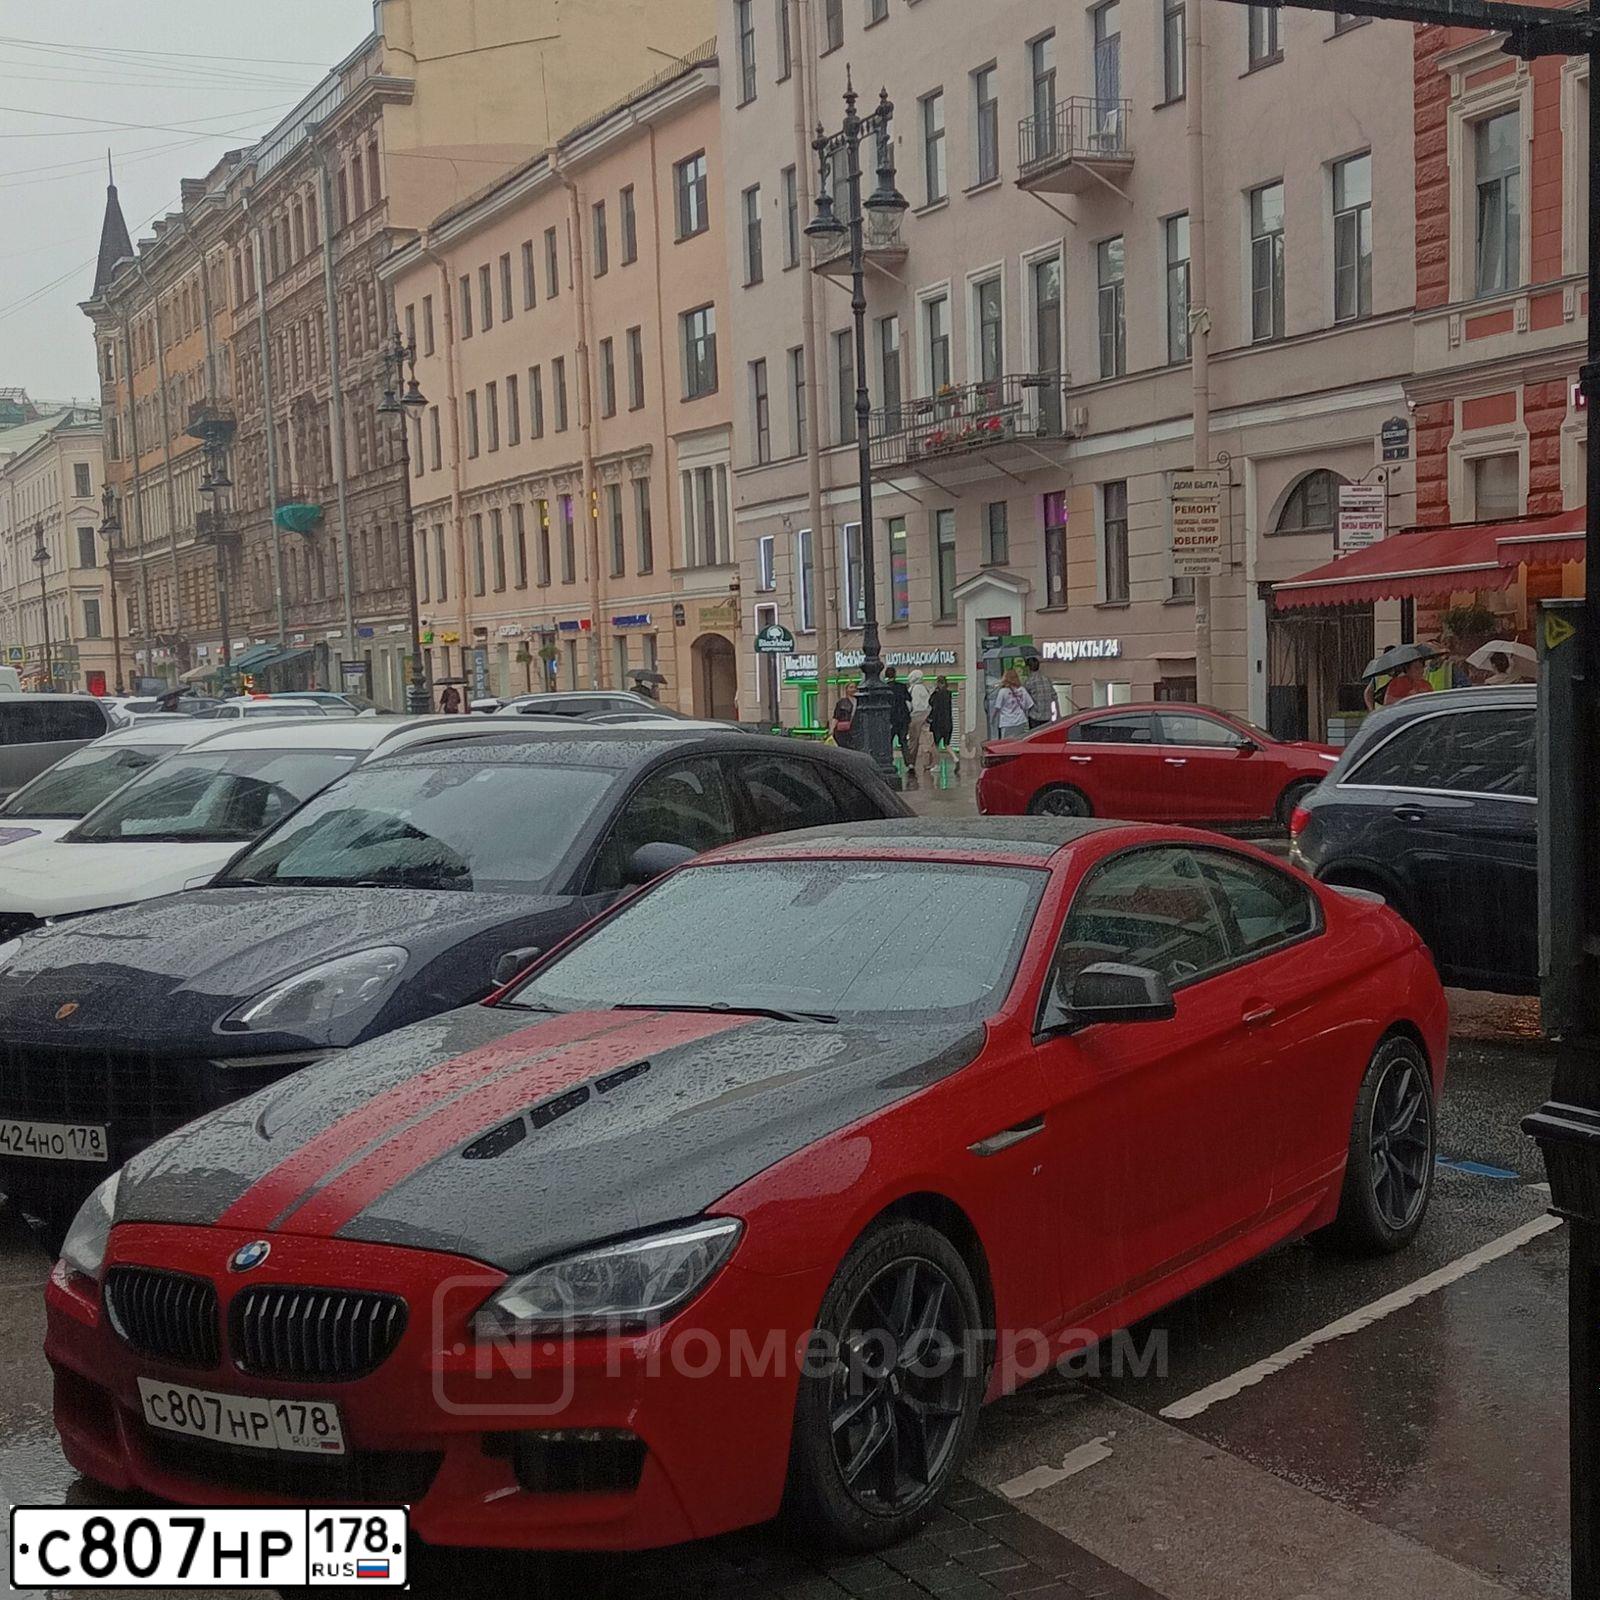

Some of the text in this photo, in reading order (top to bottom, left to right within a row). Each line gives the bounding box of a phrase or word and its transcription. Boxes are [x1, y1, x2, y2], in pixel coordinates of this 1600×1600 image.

[1173, 480, 1219, 490] ДОМ БЫТА
[1174, 505, 1217, 514] РЕМОНТ
[1174, 536, 1219, 545] ЮВЕЛИР
[885, 648, 956, 666] ШОТЛАНДСКИЙ ПАБ
[1042, 638, 1119, 661] ПРОДУКТЫ 24
[68, 1128, 101, 1150] 178
[150, 1390, 330, 1441] С807НР 178
[292, 1435, 320, 1448] RUS
